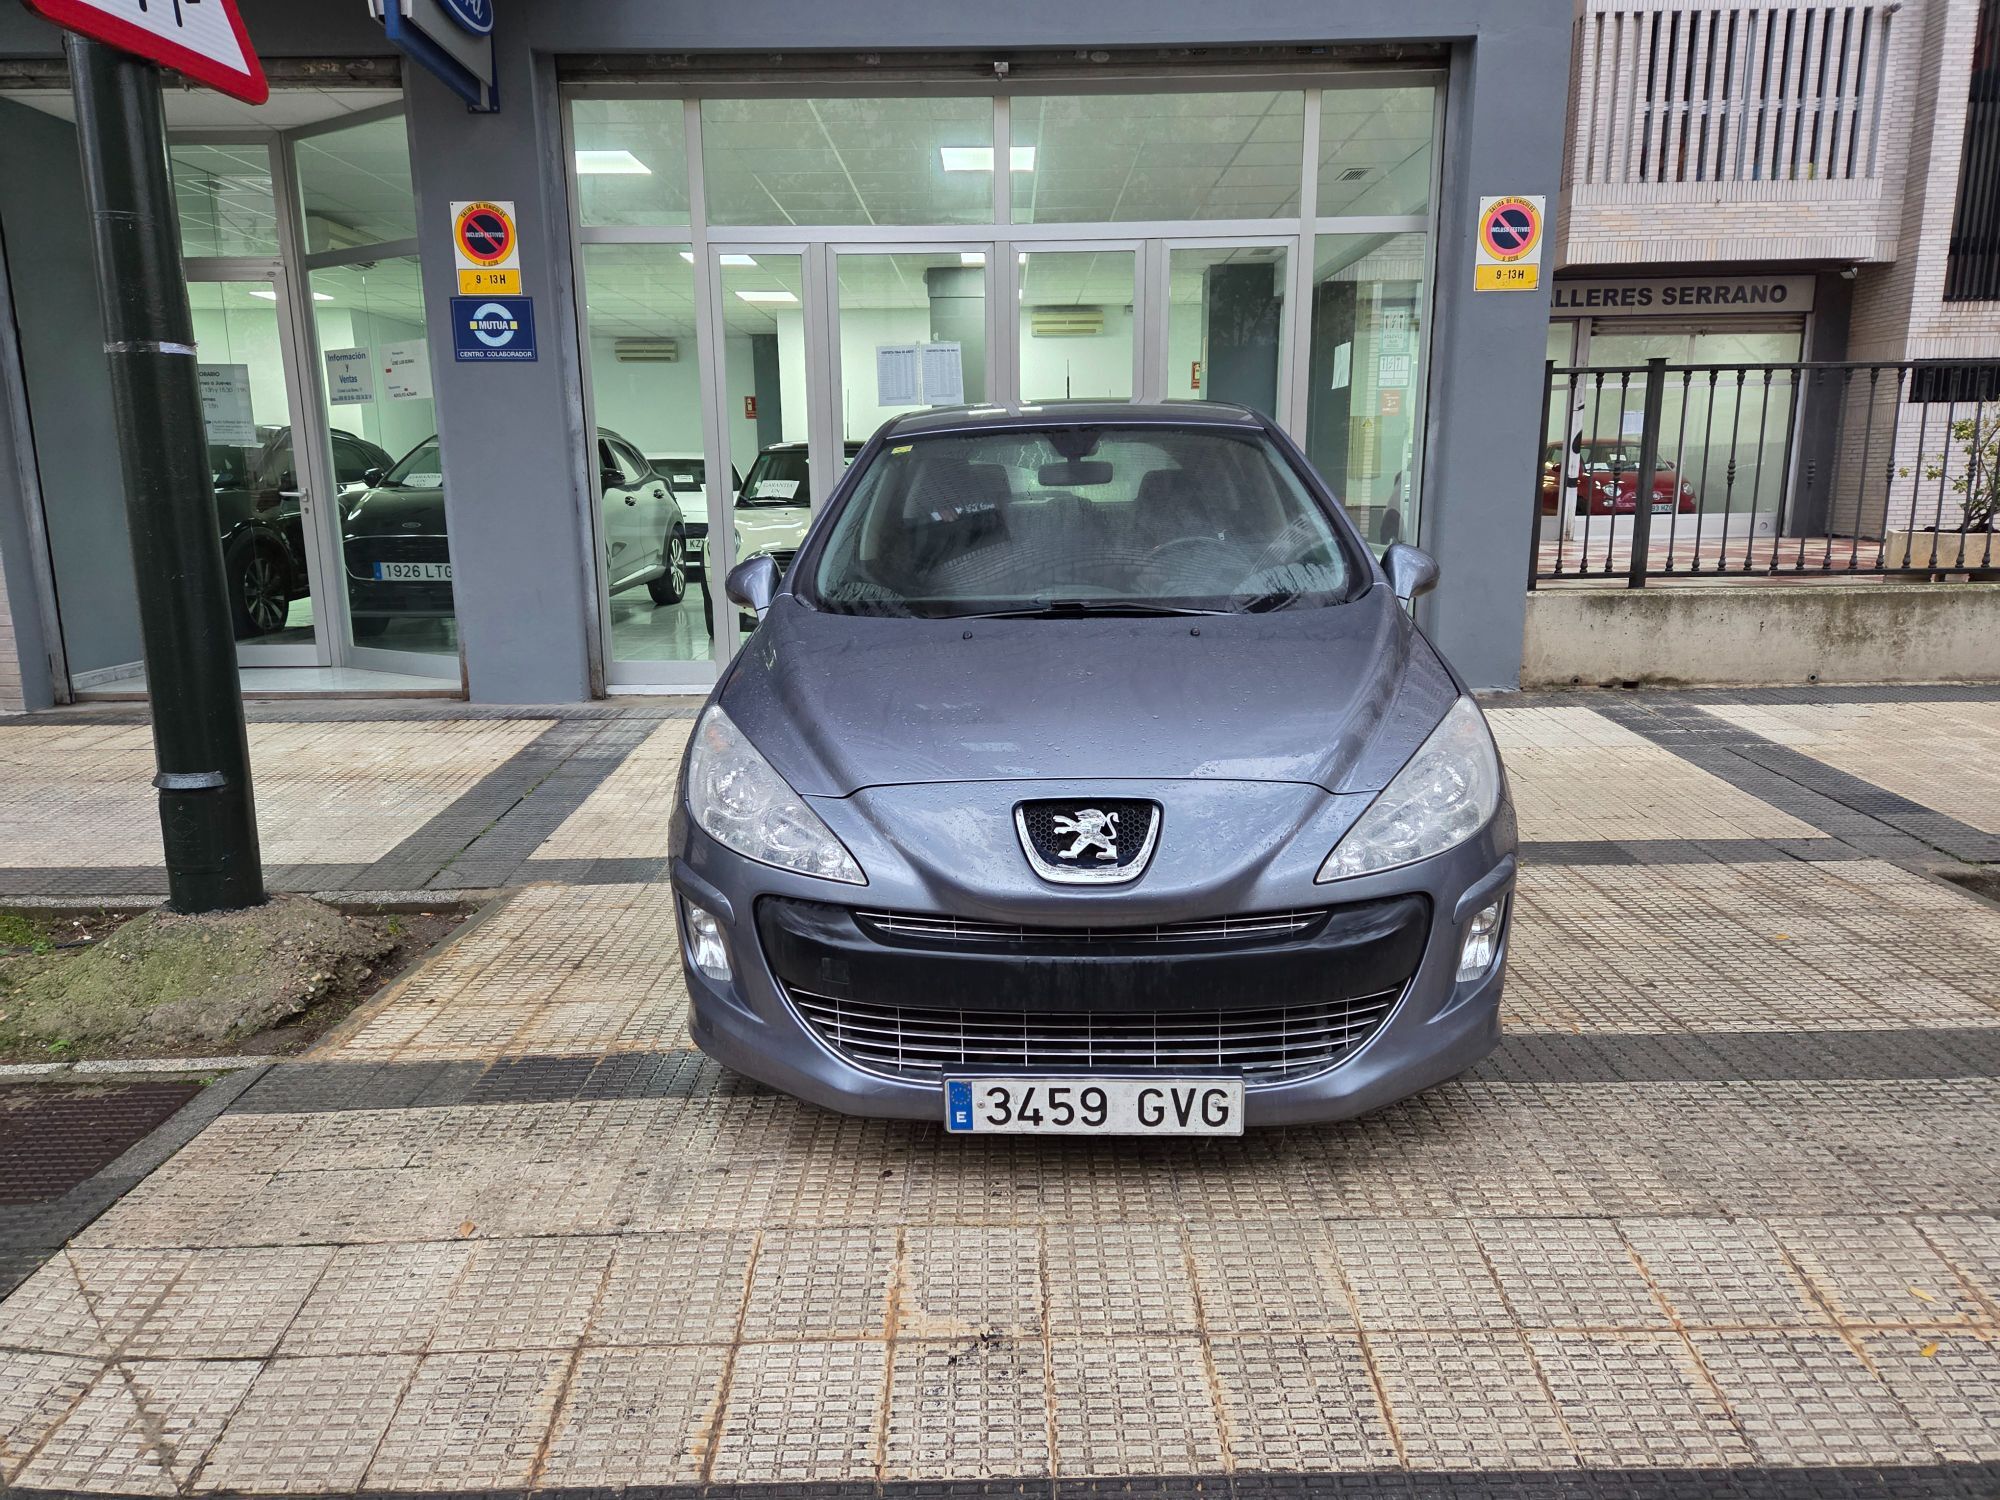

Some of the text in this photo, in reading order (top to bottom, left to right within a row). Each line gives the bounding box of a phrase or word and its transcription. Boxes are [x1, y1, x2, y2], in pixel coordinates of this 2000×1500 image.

[1489, 200, 1504, 213] SALIDA
[476, 274, 481, 284] 9
[1551, 284, 1788, 308] LLERES SERRANO
[478, 320, 509, 330] MUTUA
[327, 352, 367, 362] Información
[339, 374, 358, 384] Ventas
[386, 564, 452, 578] 1926 LTG
[956, 1086, 1229, 1128] E 3459 GVG
